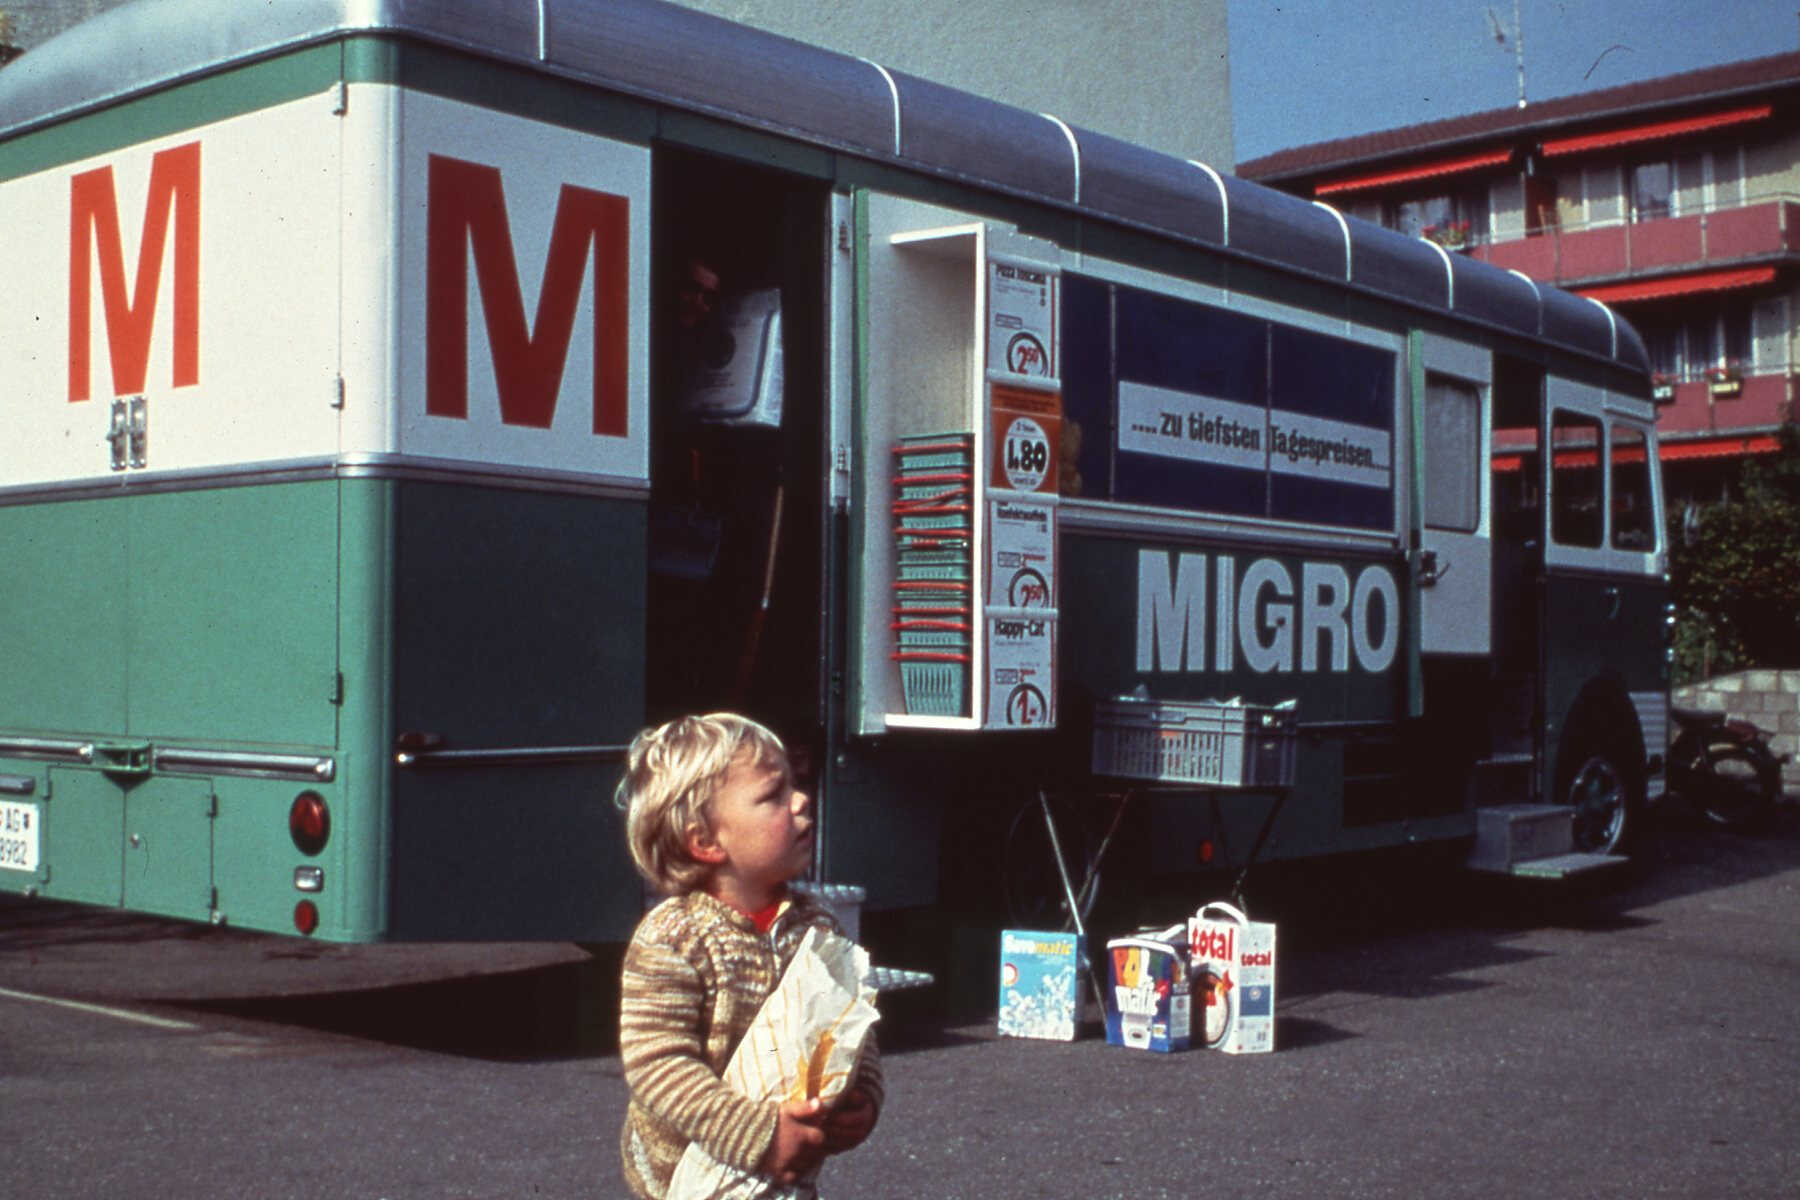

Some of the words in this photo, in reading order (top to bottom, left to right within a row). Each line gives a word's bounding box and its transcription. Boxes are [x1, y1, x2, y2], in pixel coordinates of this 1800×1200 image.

[68, 140, 201, 403] M
[426, 153, 629, 438] M
[1188, 412, 1260, 450] tiefsten
[1137, 549, 1398, 672] MIGRO
[1192, 927, 1234, 961] total
[1241, 950, 1271, 967] total
